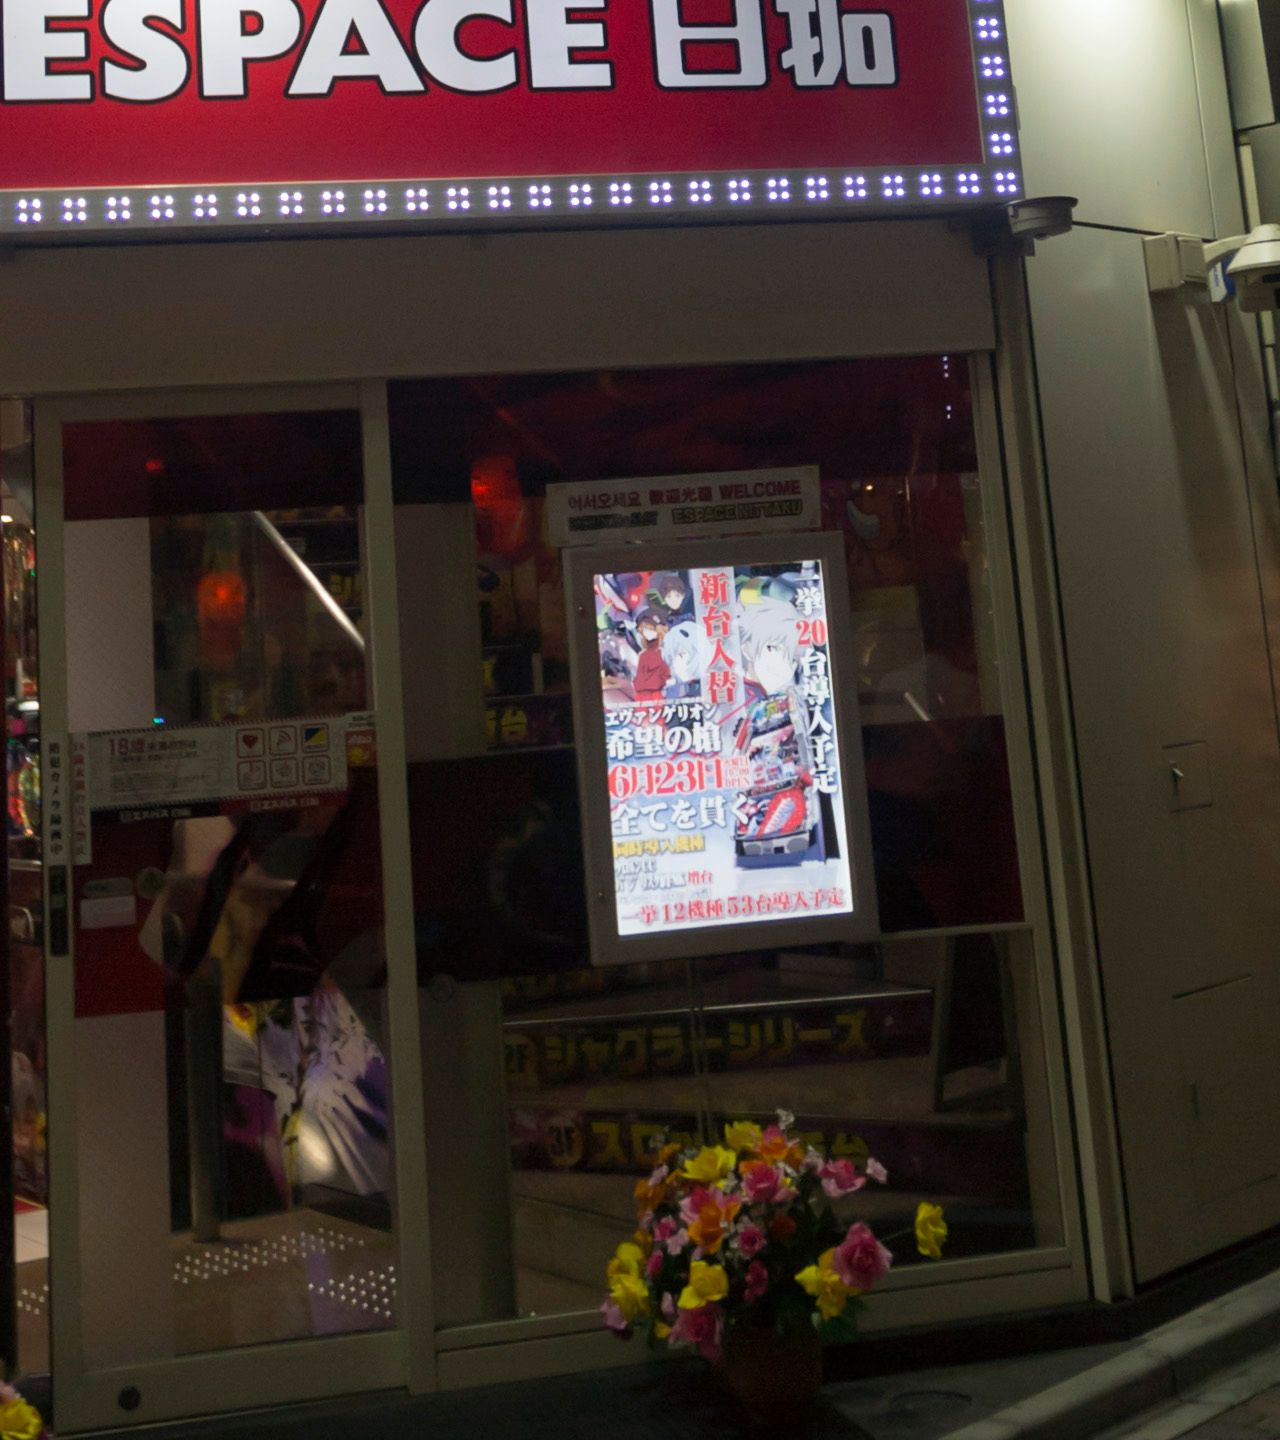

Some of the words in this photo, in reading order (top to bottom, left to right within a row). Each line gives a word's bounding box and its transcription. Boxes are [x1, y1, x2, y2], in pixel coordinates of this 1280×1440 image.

[718, 479, 802, 500] WELCOME
[699, 570, 738, 706] 新台入替
[605, 703, 720, 727] エヴァンゲリオン
[606, 721, 721, 760] 希望の槍
[609, 756, 723, 800] 6月23日
[611, 794, 756, 837] 全てを貫く
